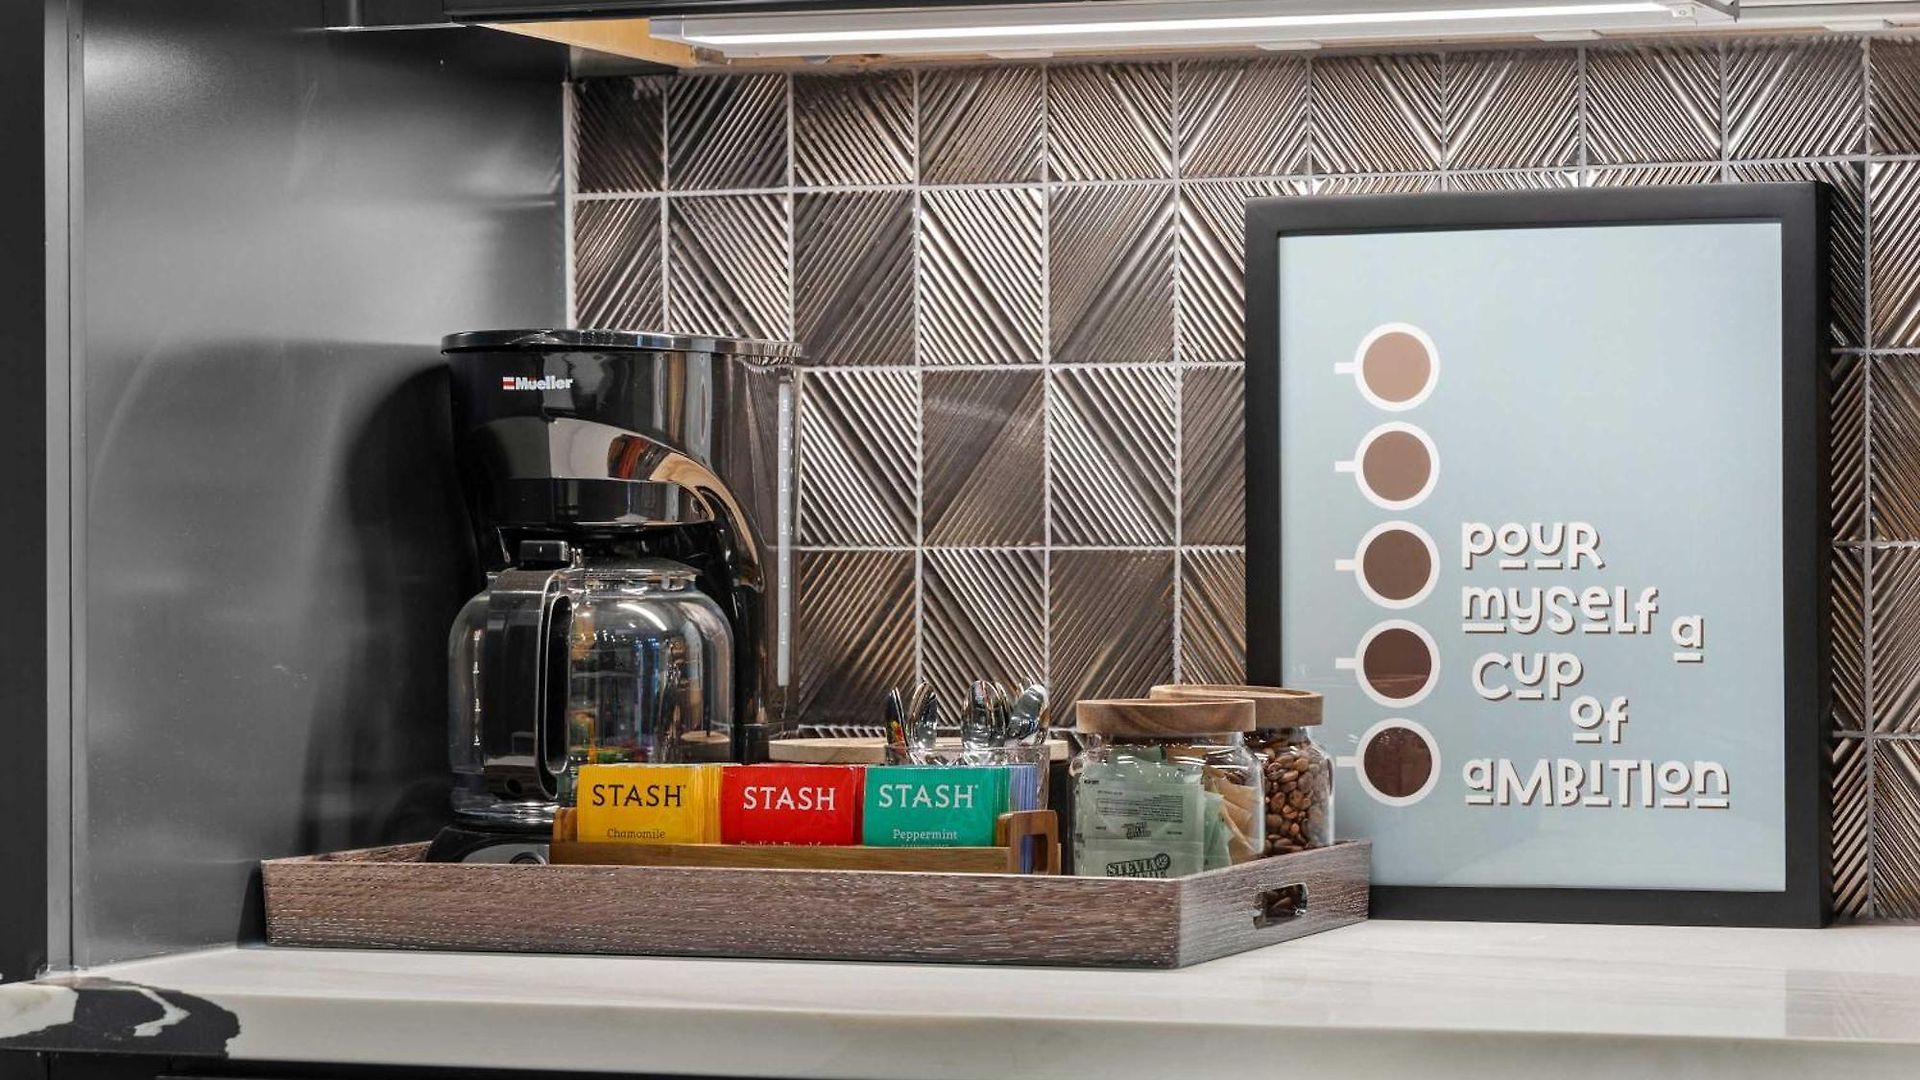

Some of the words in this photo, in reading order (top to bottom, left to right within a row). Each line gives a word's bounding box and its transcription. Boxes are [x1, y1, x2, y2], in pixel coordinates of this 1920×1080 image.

[1569, 695, 1629, 744] of
[592, 783, 682, 807] STASH
[742, 786, 835, 811] STASH
[878, 784, 974, 808] STASH
[607, 828, 666, 839] Chamomile
[893, 828, 958, 841] Peppermint
